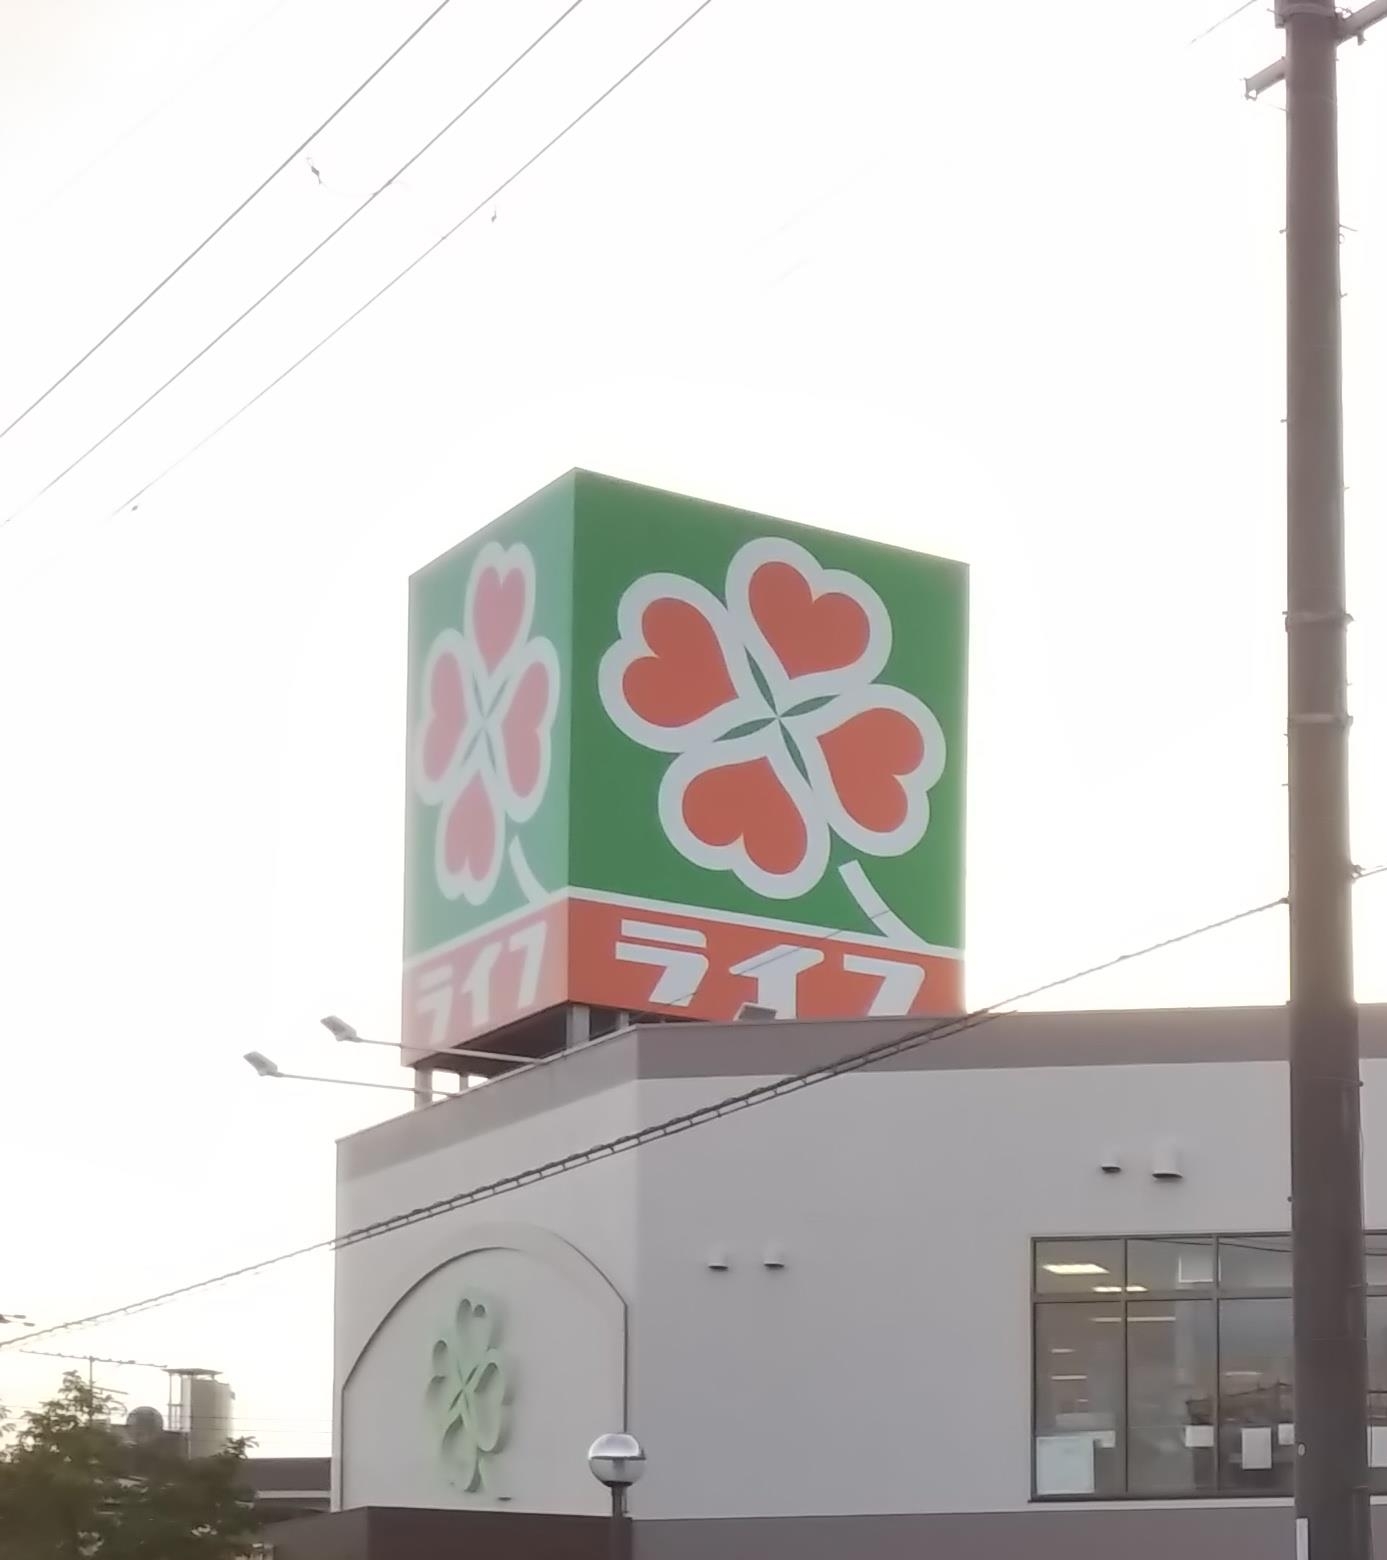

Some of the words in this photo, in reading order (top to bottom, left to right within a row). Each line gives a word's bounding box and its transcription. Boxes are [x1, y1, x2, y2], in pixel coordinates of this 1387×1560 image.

[417, 922, 548, 1044] ライフ
[615, 918, 926, 1020] ライフ
